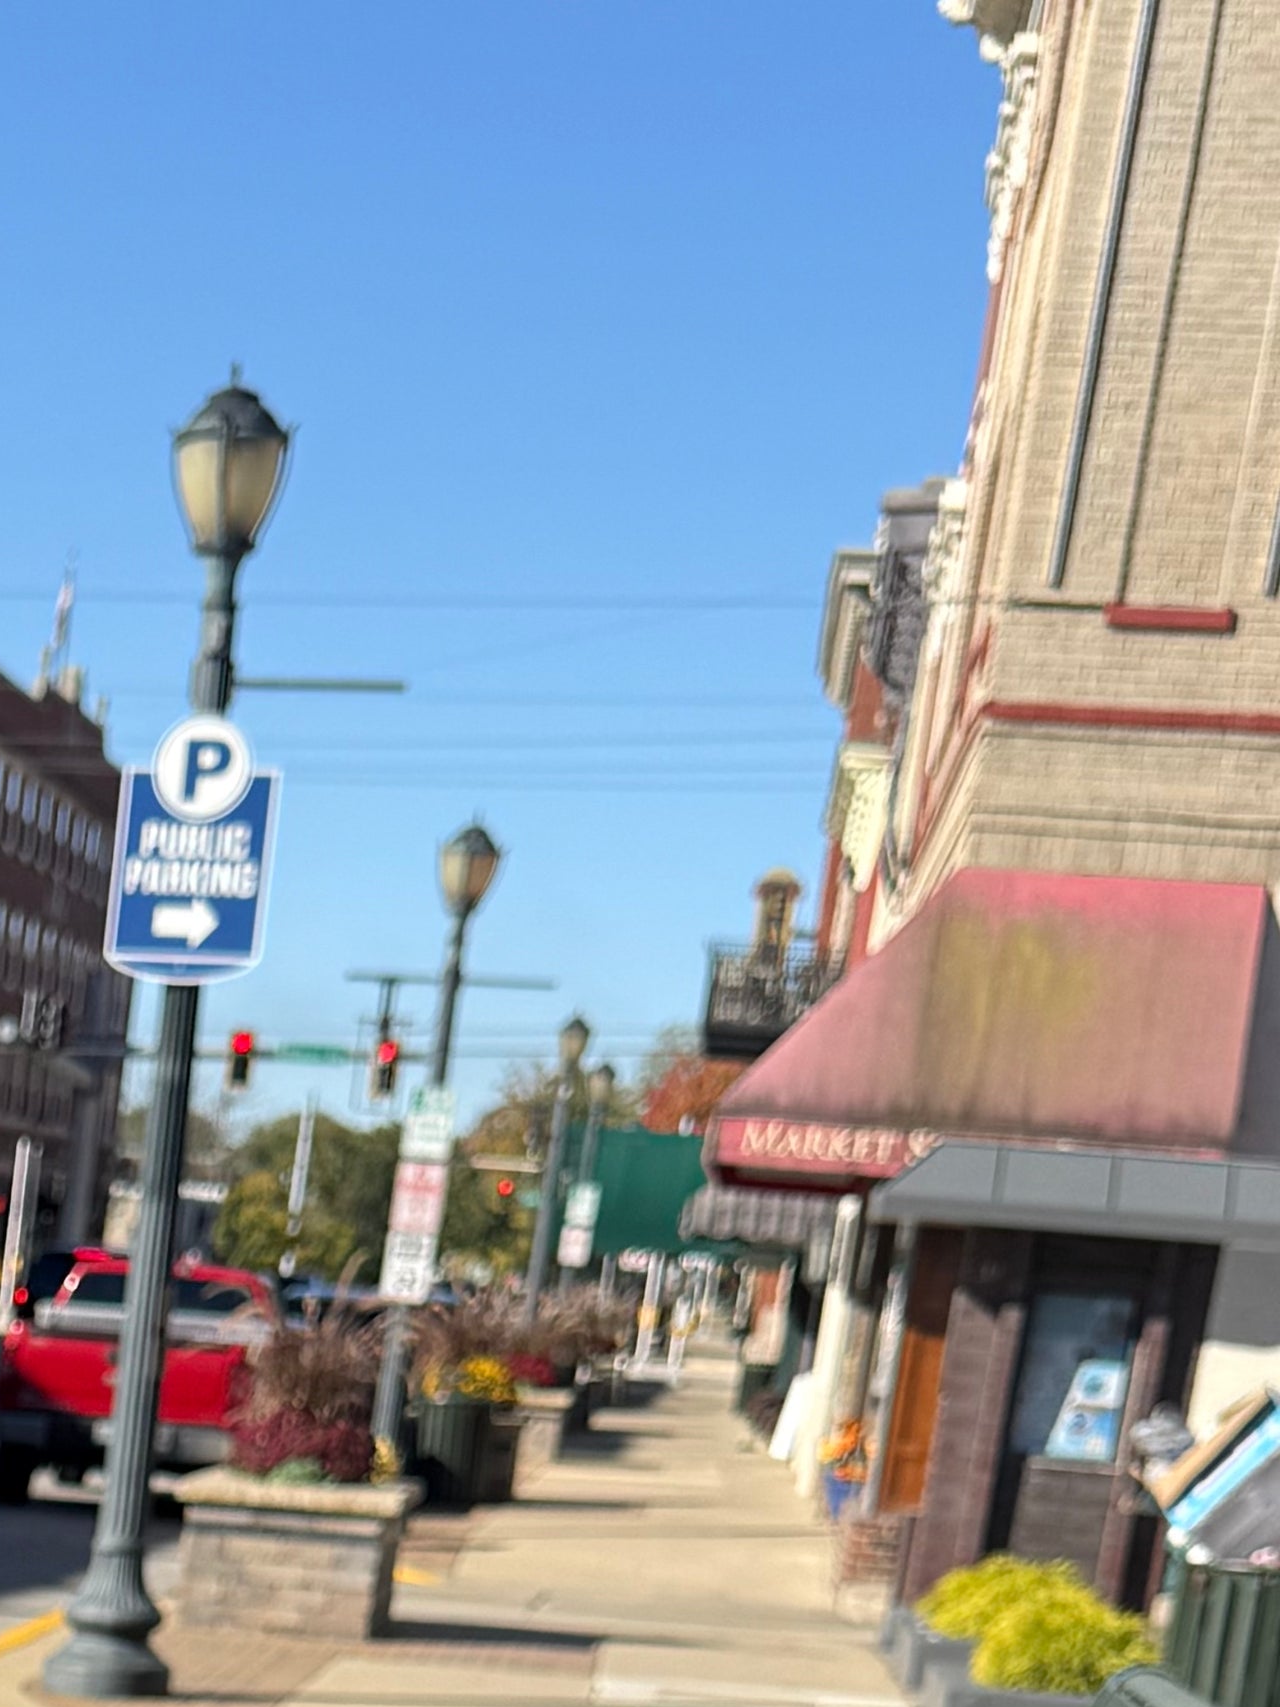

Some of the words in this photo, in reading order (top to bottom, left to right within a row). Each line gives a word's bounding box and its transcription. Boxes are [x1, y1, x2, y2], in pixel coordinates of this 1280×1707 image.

[183, 740, 232, 802] P
[139, 818, 253, 860] PUBLIC
[123, 857, 260, 899] PARKING
[740, 1117, 904, 1165] MARKET
